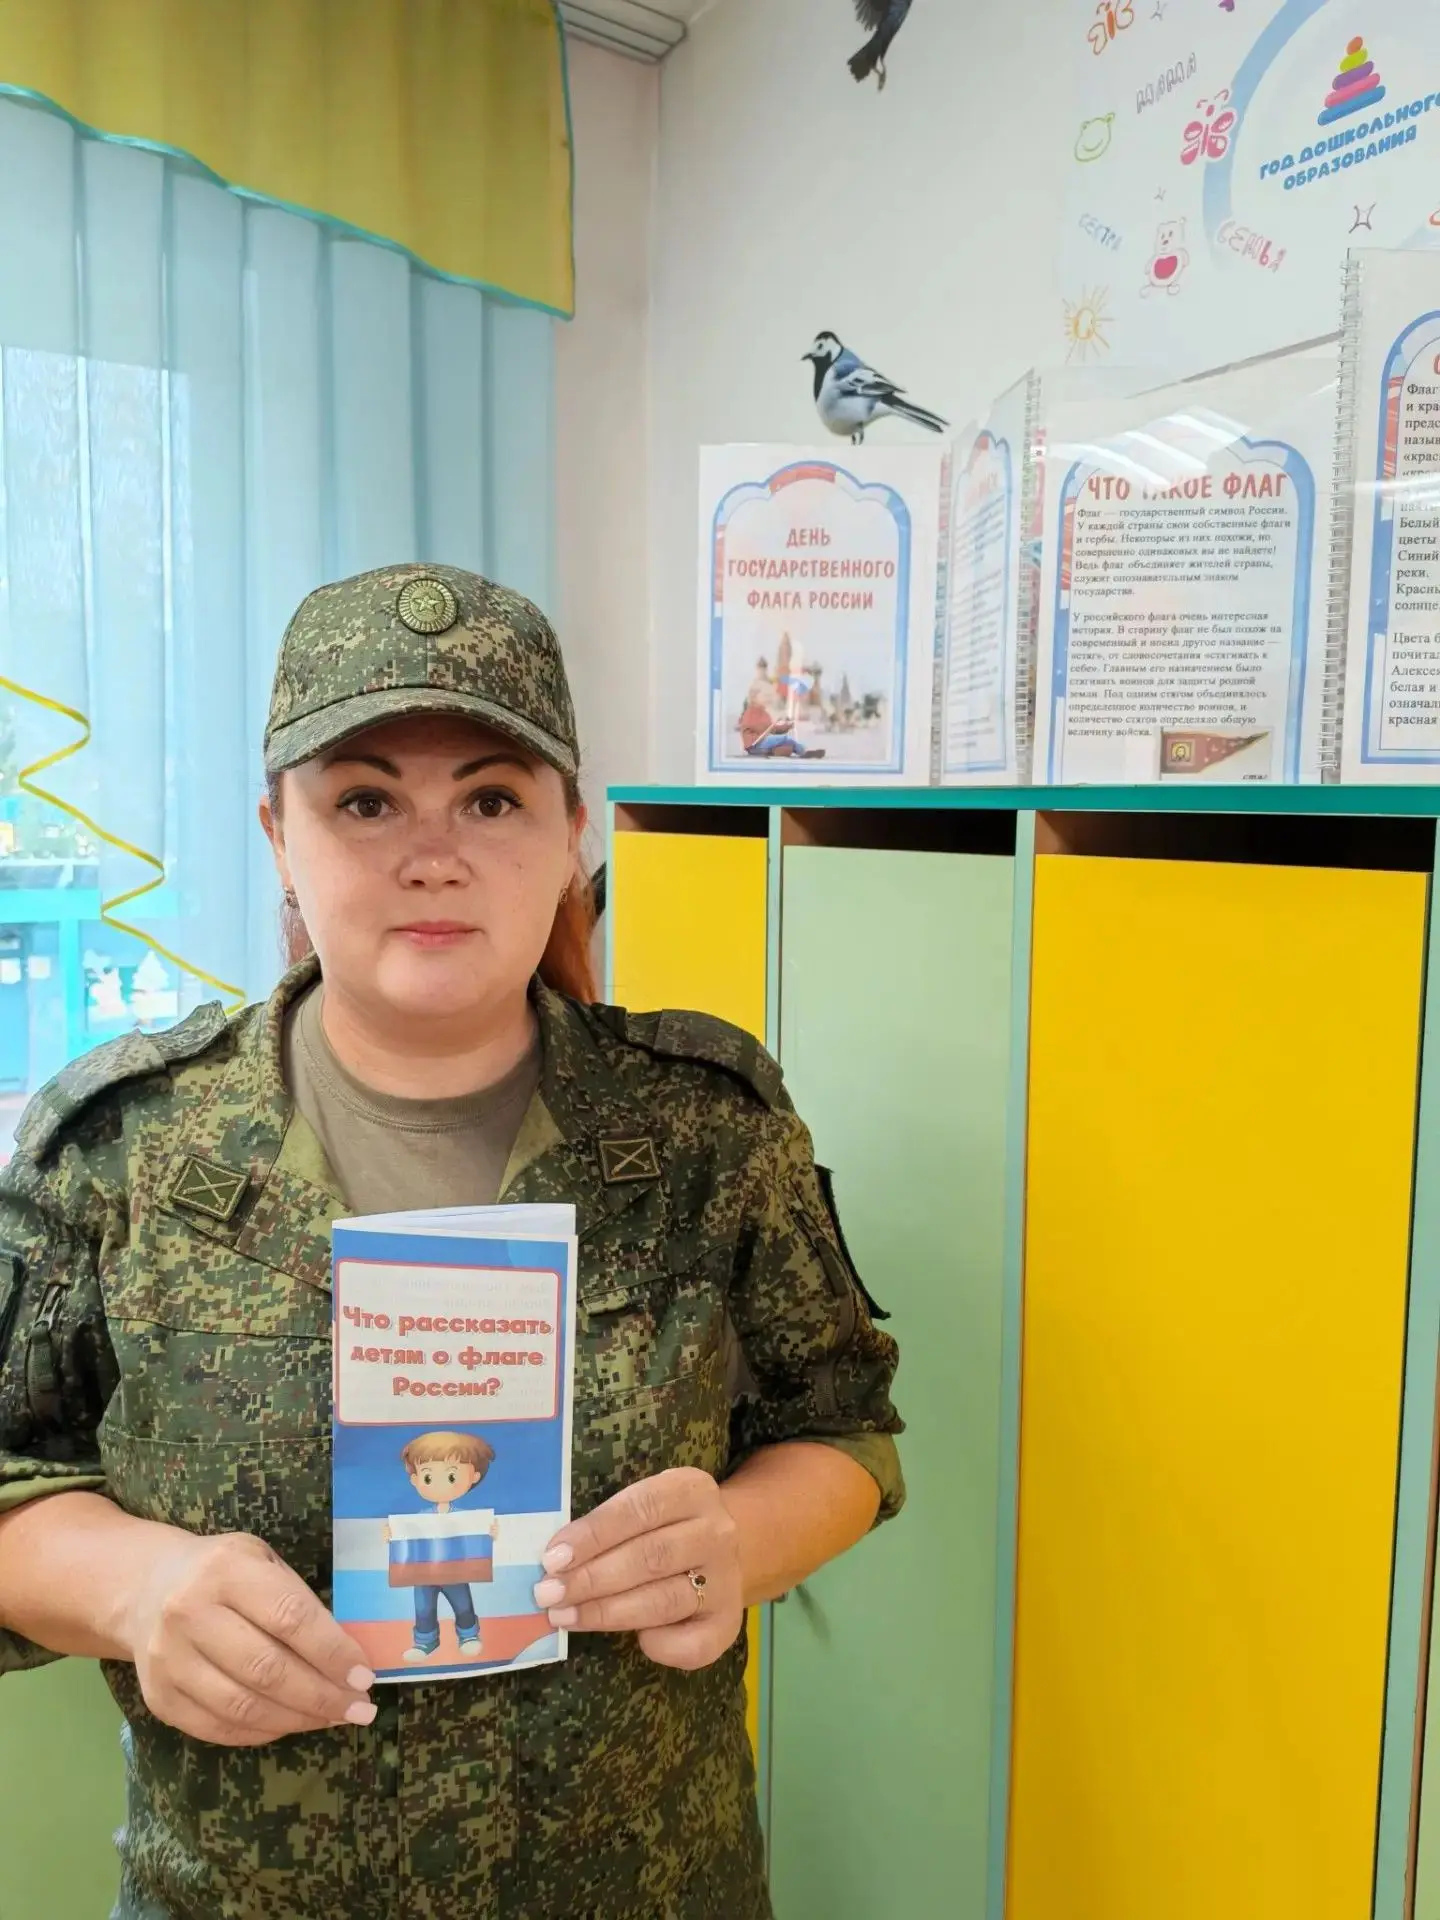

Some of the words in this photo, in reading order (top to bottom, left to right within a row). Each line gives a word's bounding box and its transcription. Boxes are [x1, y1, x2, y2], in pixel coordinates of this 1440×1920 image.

[1283, 124, 1418, 190] ОБРАЗОВАНИЯ
[1260, 155, 1295, 180] ГОД
[1407, 383, 1437, 395] Флаг
[1418, 403, 1440, 414] кра
[1088, 476, 1130, 500] ЧТО
[1223, 472, 1287, 499] ФЛАГ
[1078, 507, 1101, 518] Флаг
[1120, 506, 1205, 518] государственный
[1208, 508, 1245, 516] символ
[1248, 506, 1288, 516] России.
[1088, 521, 1124, 531] каждой
[1127, 522, 1163, 531] страны
[1166, 521, 1190, 529] свои
[1192, 519, 1258, 529] собственные
[1261, 519, 1291, 530] флаги
[1400, 516, 1440, 528] Белый
[786, 528, 831, 547] ДЕНЬ
[1121, 533, 1175, 544] Некоторые
[1193, 534, 1211, 542] них
[1399, 536, 1437, 546] цветы
[1075, 549, 1135, 558] совершенно
[1138, 547, 1198, 556] одинаковых
[1201, 547, 1214, 555] вы
[1217, 547, 1230, 555] не
[1398, 549, 1439, 561] Синий
[728, 559, 895, 579] ГОСУДАРСТВЕННОГО
[1075, 561, 1098, 570] Ведь
[1101, 559, 1124, 571] флаг
[1128, 560, 1185, 569] объединяет
[1189, 559, 1231, 569] жителей
[1396, 570, 1429, 580] реки.
[747, 589, 801, 610] ФЛАГА
[809, 589, 874, 610] РОССИИ
[1083, 612, 1145, 623] российского
[1148, 611, 1176, 622] флага
[1179, 613, 1208, 621] очень
[1211, 612, 1269, 622] интересная
[1128, 626, 1167, 636] старину
[1171, 624, 1194, 636] флаг
[1212, 623, 1232, 633] был
[1235, 625, 1267, 633] похож
[1071, 638, 1137, 648] современный
[1149, 639, 1179, 647] носил
[1181, 639, 1217, 649] другое
[1219, 639, 1265, 647] название
[1393, 632, 1430, 644] Цвета
[1122, 651, 1201, 660] словосочетания
[1103, 663, 1147, 673] Главным
[1150, 665, 1165, 673] его
[1168, 664, 1232, 673] назначением
[1235, 663, 1262, 672] было
[1120, 678, 1154, 686] воинов
[1157, 678, 1175, 686] для
[1219, 676, 1256, 687] родной
[1390, 680, 1425, 692] белая
[1104, 689, 1123, 699] Под
[1126, 690, 1157, 698] одним
[1160, 689, 1194, 698] стягом
[1196, 688, 1267, 698] объединялось
[1125, 716, 1157, 724] стягов
[1220, 714, 1257, 726] общую
[1388, 716, 1437, 727] красная
[1068, 727, 1112, 738] величину
[343, 1306, 391, 1330] Что
[398, 1315, 553, 1337] рассказать
[351, 1346, 424, 1365] детям
[432, 1349, 450, 1365] о
[458, 1345, 545, 1371] флаге
[393, 1376, 502, 1397] России?
